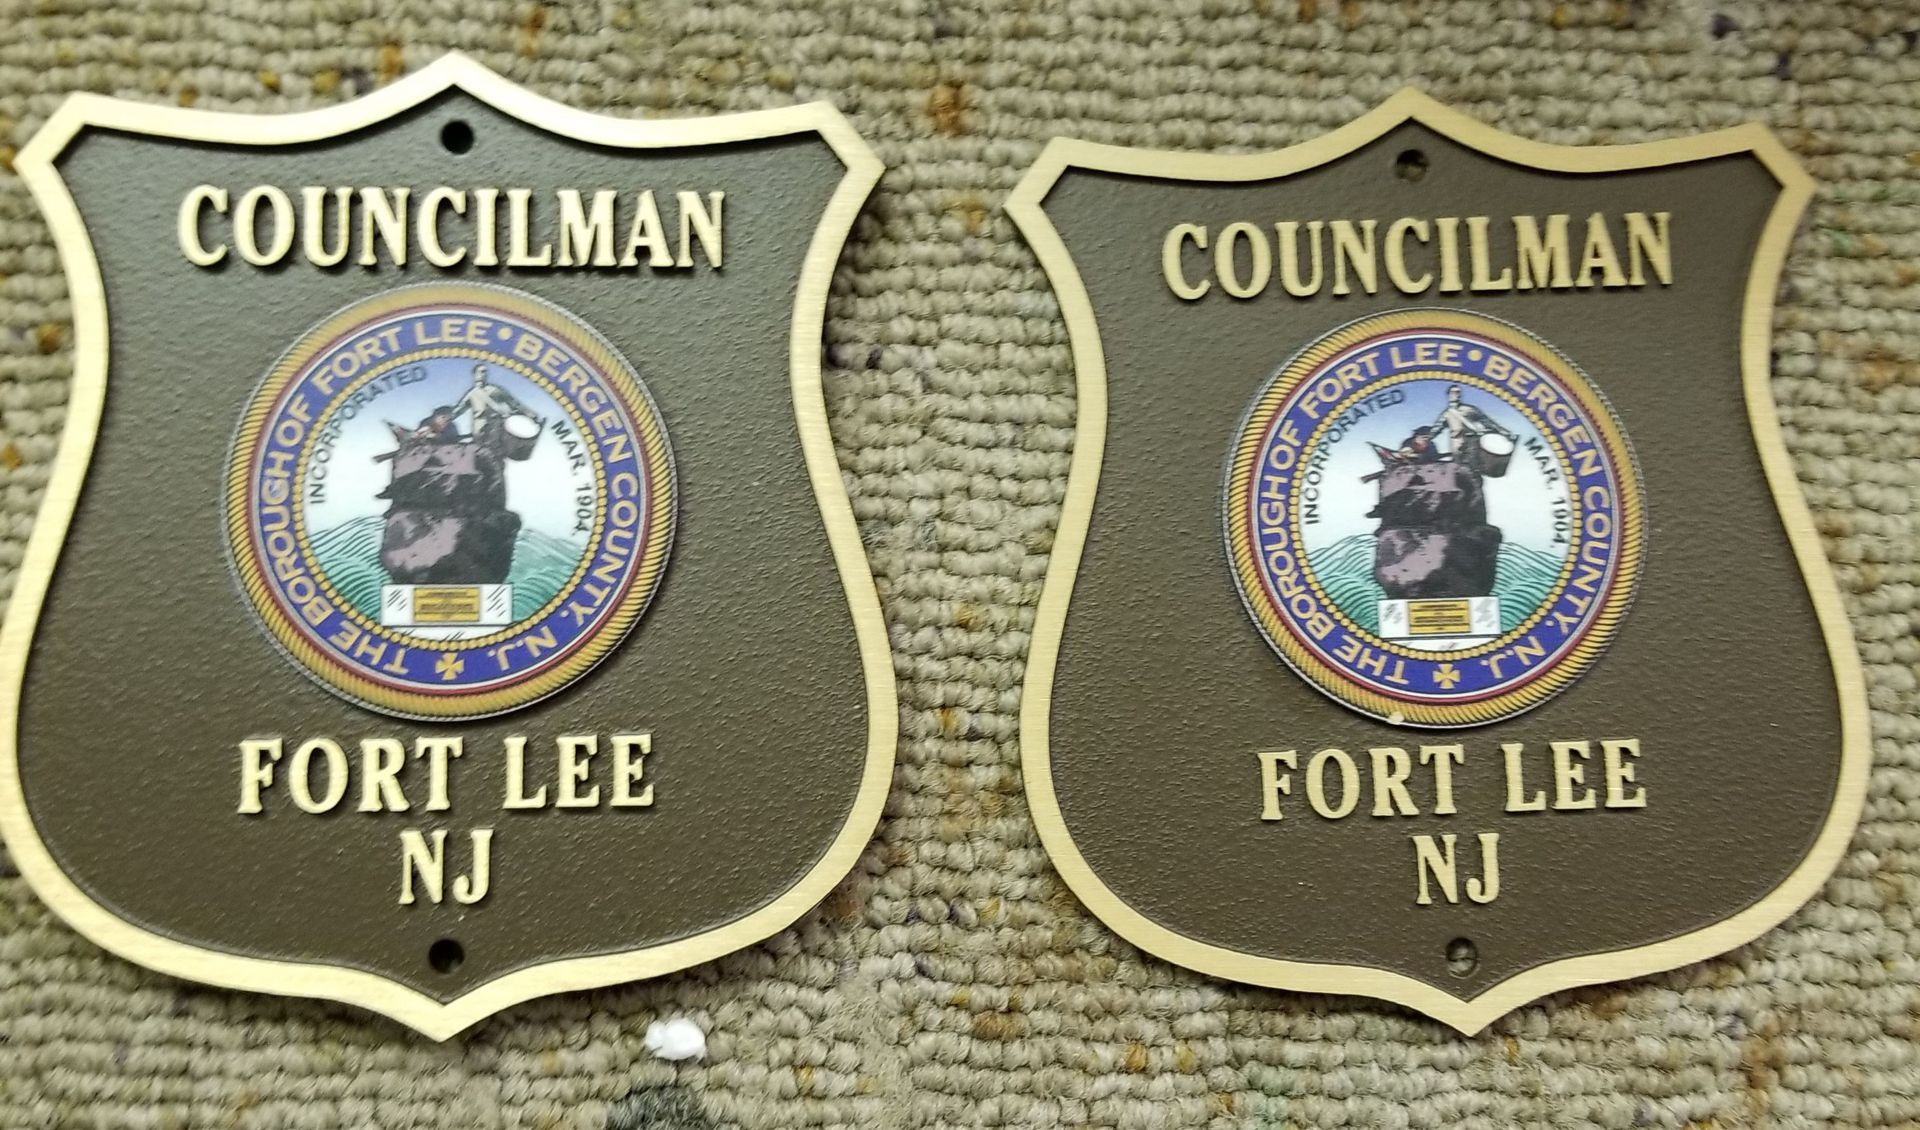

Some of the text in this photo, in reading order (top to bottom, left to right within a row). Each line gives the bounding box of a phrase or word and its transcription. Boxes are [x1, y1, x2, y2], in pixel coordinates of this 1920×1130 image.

[177, 184, 725, 268] COUNCILMAN
[1161, 211, 1673, 300] COUNCILMAN
[311, 326, 403, 397] FORT
[414, 319, 493, 346] LEE
[1389, 342, 1464, 369] LEE
[513, 333, 633, 464] BERGEN
[1300, 351, 1382, 419] FORT
[1483, 354, 1603, 477] BERGEN
[277, 399, 315, 448] OF
[308, 365, 428, 504] INCORPORATED
[551, 420, 586, 477] MAR.
[1270, 426, 1302, 470] OF
[1304, 388, 1406, 524] INCORPORATED
[260, 451, 333, 626] BOROUGH
[1260, 475, 1336, 638] BOROUGH
[328, 630, 408, 675] THE
[487, 625, 559, 672] N.J.
[1333, 636, 1409, 684] THE
[1479, 635, 1548, 679] N.J.
[237, 733, 654, 814] FORT LEE
[1257, 738, 1648, 821] FORT LEE
[398, 829, 494, 904] NJ
[1412, 832, 1500, 905] NJ
